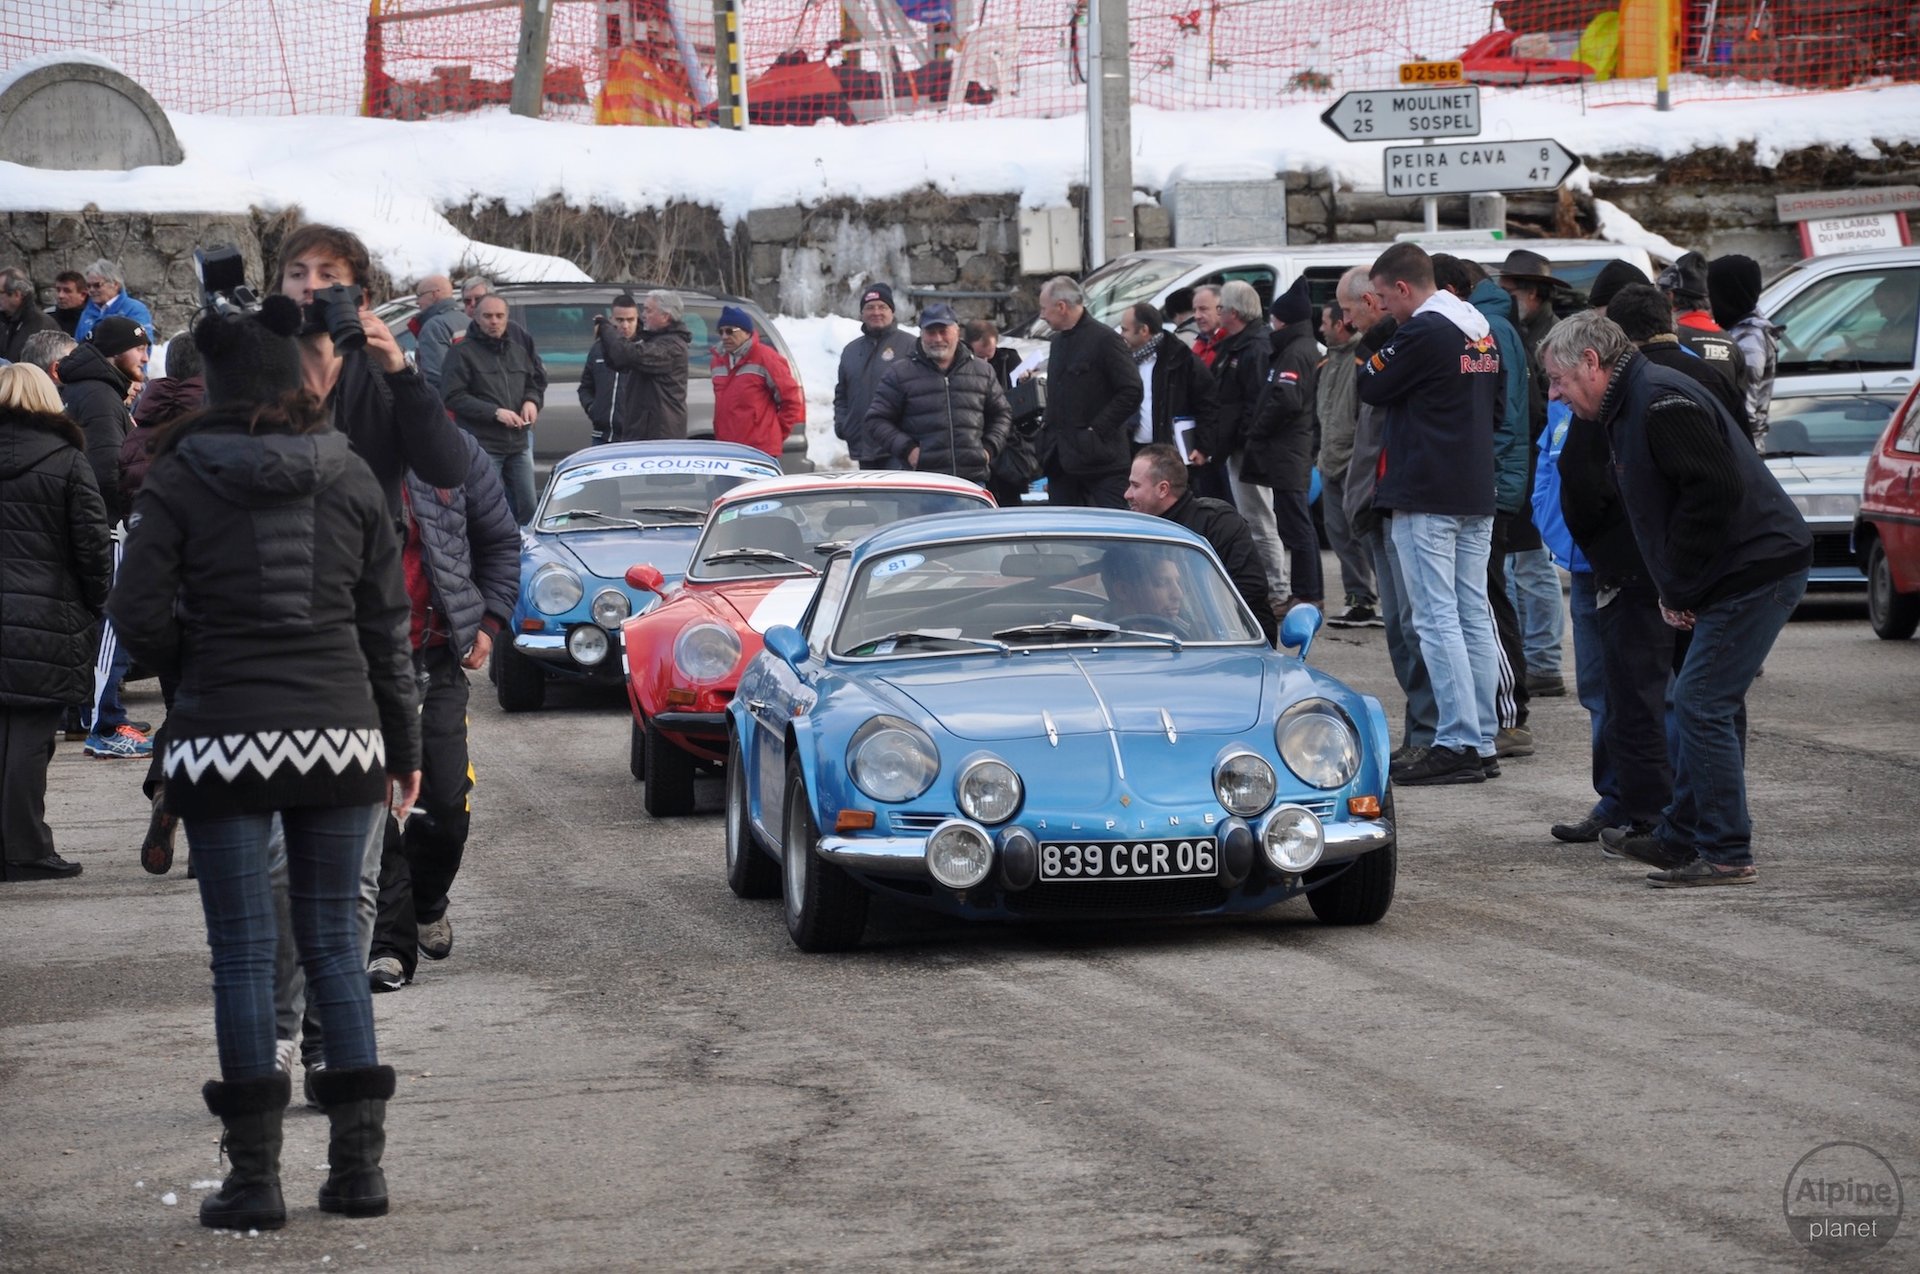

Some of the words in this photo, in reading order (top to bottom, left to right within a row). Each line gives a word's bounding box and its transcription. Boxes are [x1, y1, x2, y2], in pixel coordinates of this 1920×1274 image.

[1356, 99, 1373, 113] 12
[1393, 94, 1472, 112] MOULINET
[1353, 119, 1374, 133] 25
[1409, 115, 1473, 131] SOSPEL
[1392, 153, 1448, 168] PEIRA
[1460, 150, 1506, 165] CAVA
[1540, 147, 1550, 161] 8
[1393, 173, 1440, 188] NICE
[1528, 167, 1551, 181] 47
[1819, 221, 1840, 232] LES
[1842, 217, 1880, 230] LAMAS
[1818, 233, 1833, 243] DU
[1836, 228, 1886, 240] MIRADOU
[640, 459, 730, 470] COUSIN
[752, 503, 769, 511] 48
[888, 559, 907, 571] 81
[1037, 813, 1215, 830] ALPINE
[1043, 844, 1103, 876] 839
[1110, 843, 1170, 875] CCR
[1176, 841, 1214, 872] 06
